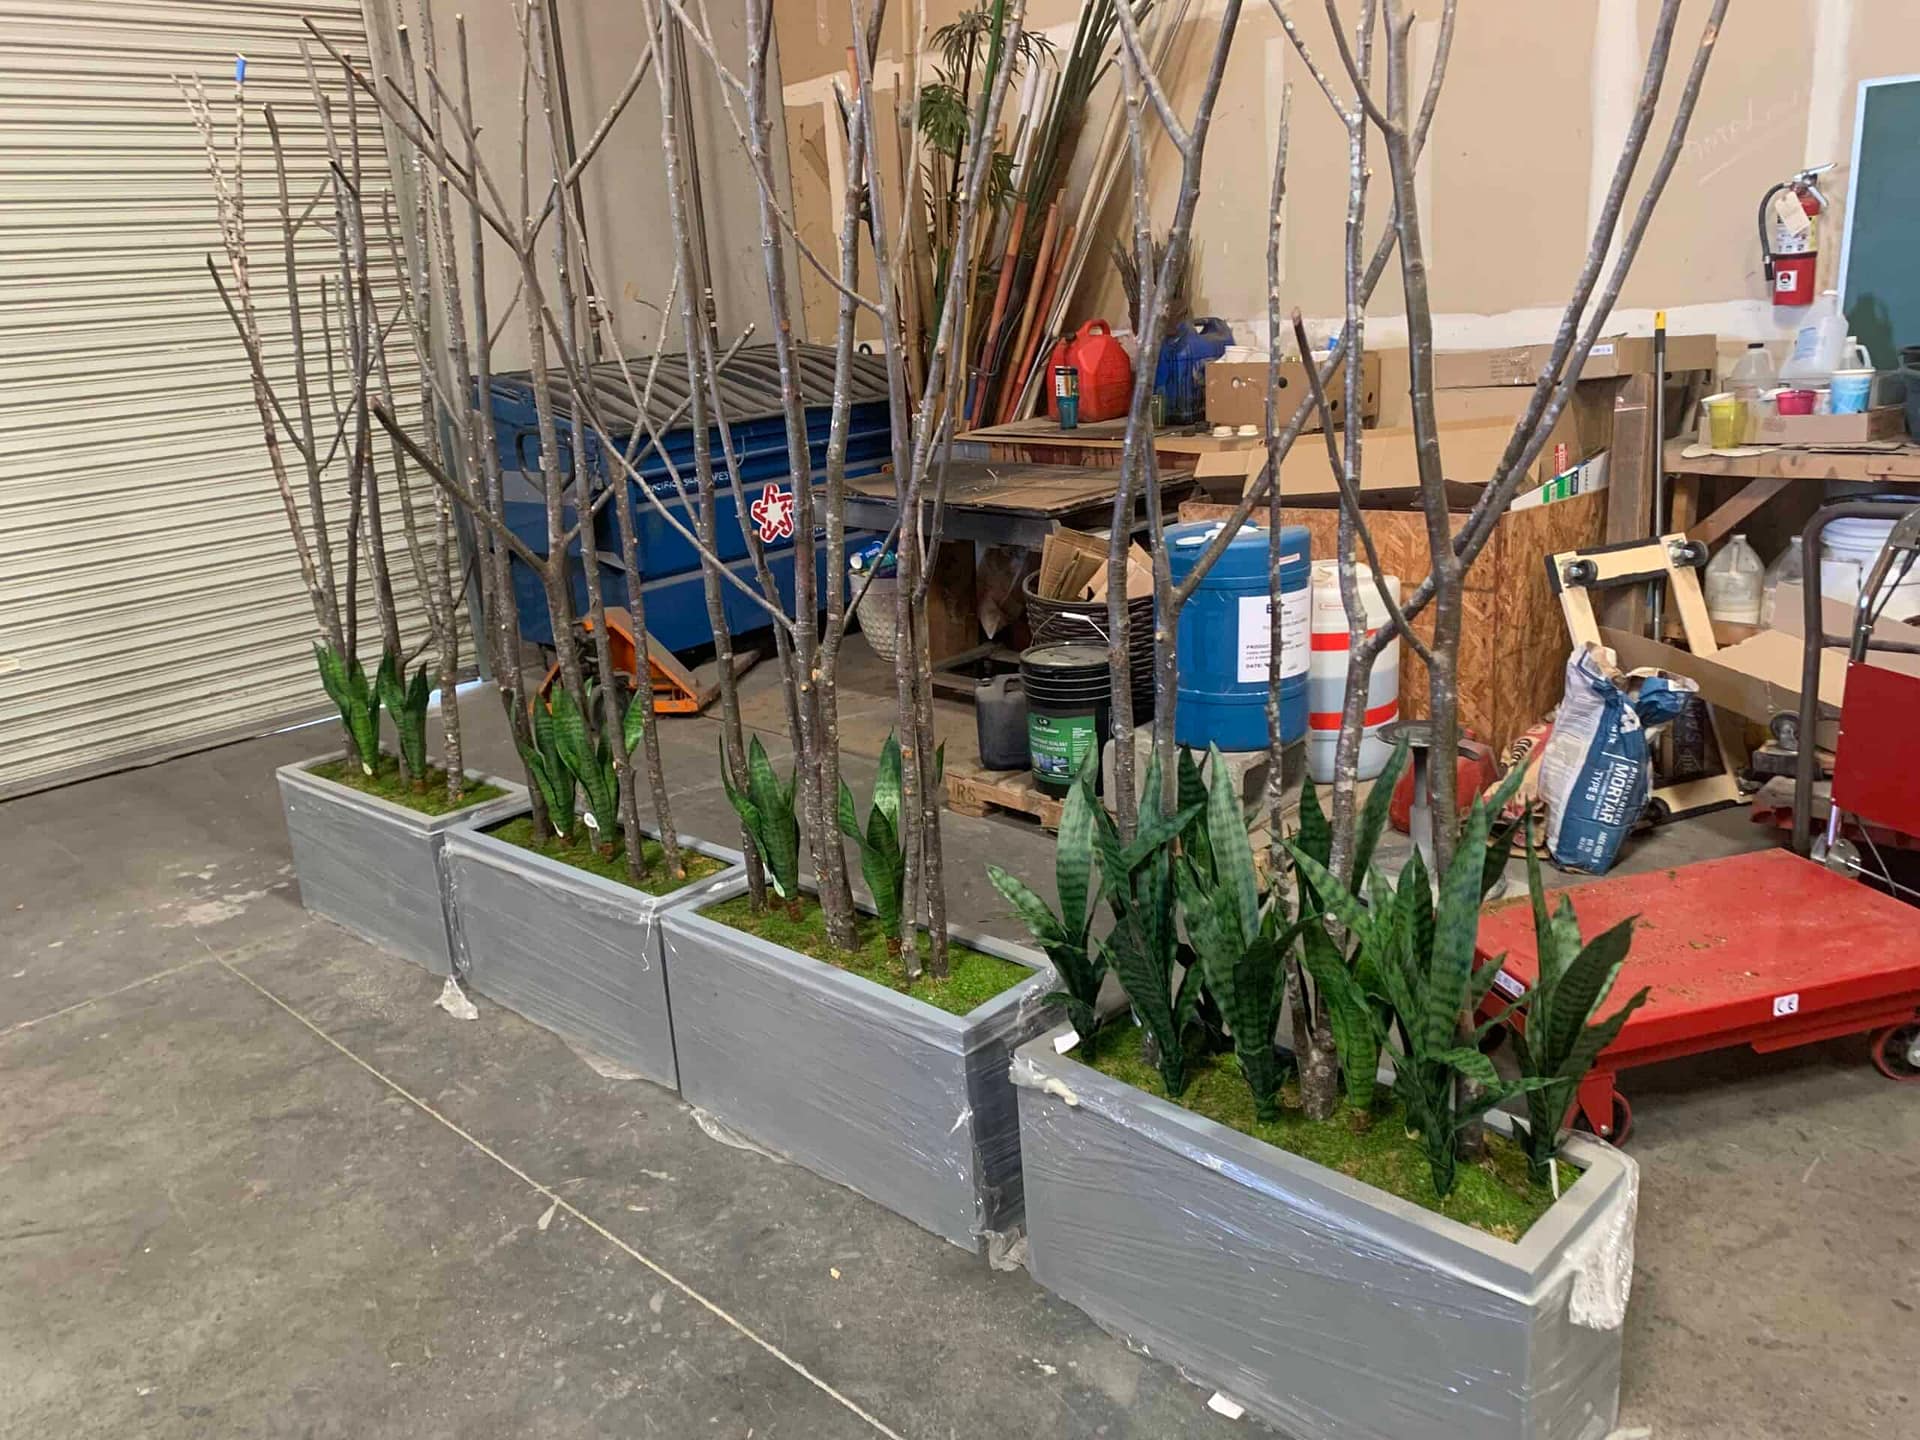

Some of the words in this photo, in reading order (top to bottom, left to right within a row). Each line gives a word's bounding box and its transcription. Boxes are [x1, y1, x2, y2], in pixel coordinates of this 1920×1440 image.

[1587, 771, 1604, 793] TYPE
[1598, 763, 1629, 823] MORTAR
[1777, 996, 1796, 1013] CE
